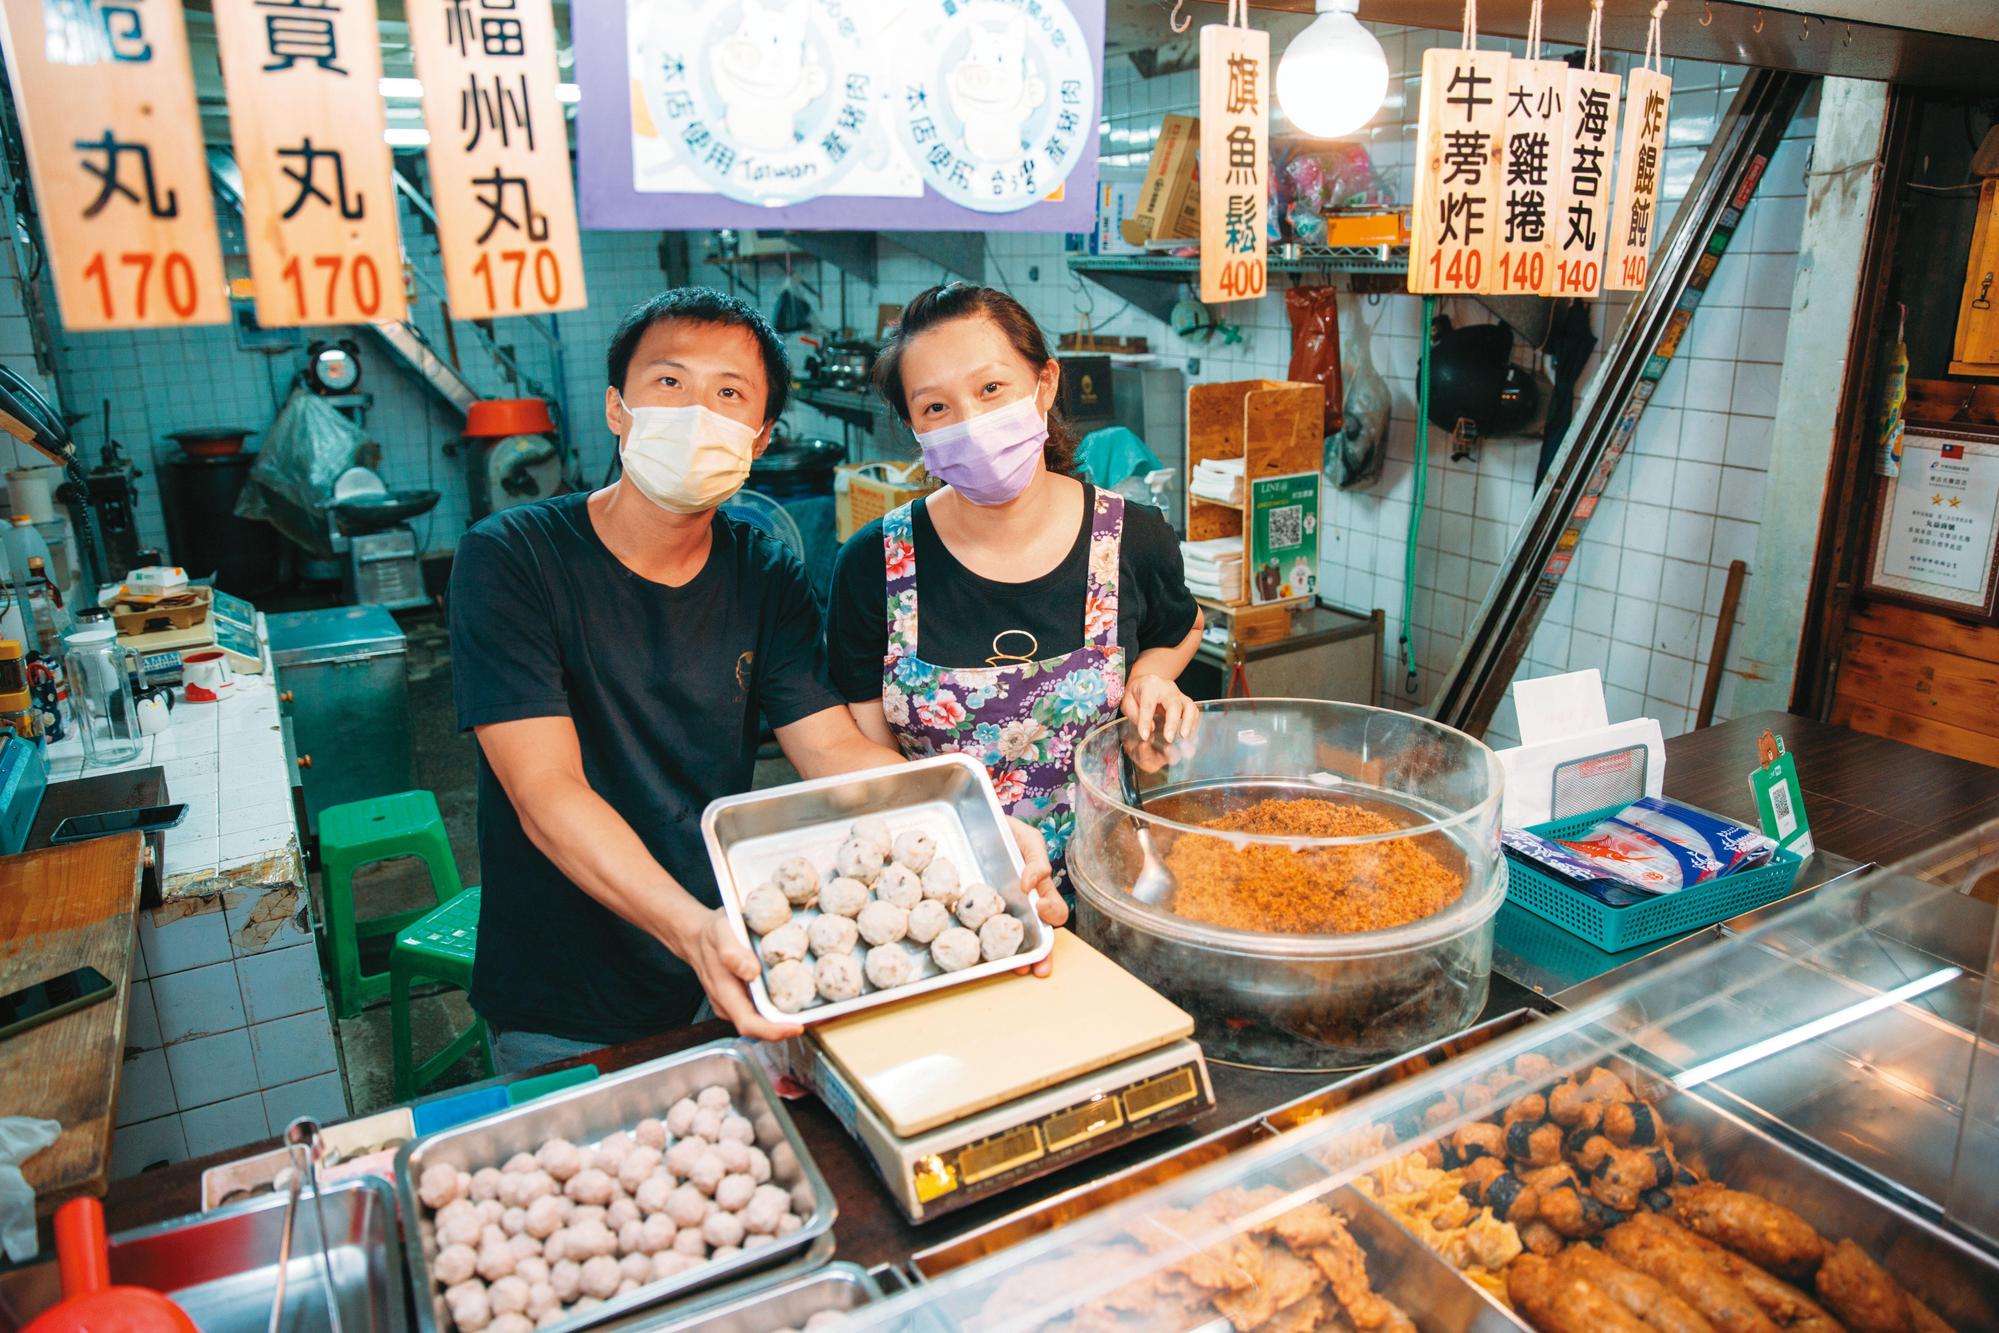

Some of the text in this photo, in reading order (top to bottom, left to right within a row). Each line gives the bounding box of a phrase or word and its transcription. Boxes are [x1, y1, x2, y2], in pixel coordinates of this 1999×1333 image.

[443, 0, 549, 245] 福州丸
[1507, 85, 1562, 119] 大小
[1225, 52, 1260, 254] 旗魚鬆
[1437, 66, 1494, 246] 牛蒡炸
[1563, 87, 1612, 252] 海苔丸
[1626, 89, 1666, 248] 炸餛飩
[1504, 132, 1551, 244] 雞捲
[83, 251, 200, 320] 170
[281, 254, 382, 318] 170
[472, 248, 562, 312] 170
[1219, 258, 1264, 297] 400
[1429, 249, 1482, 290] 140
[1500, 251, 1545, 291] 140
[1557, 259, 1599, 293] 140
[1622, 254, 1647, 288] 140
